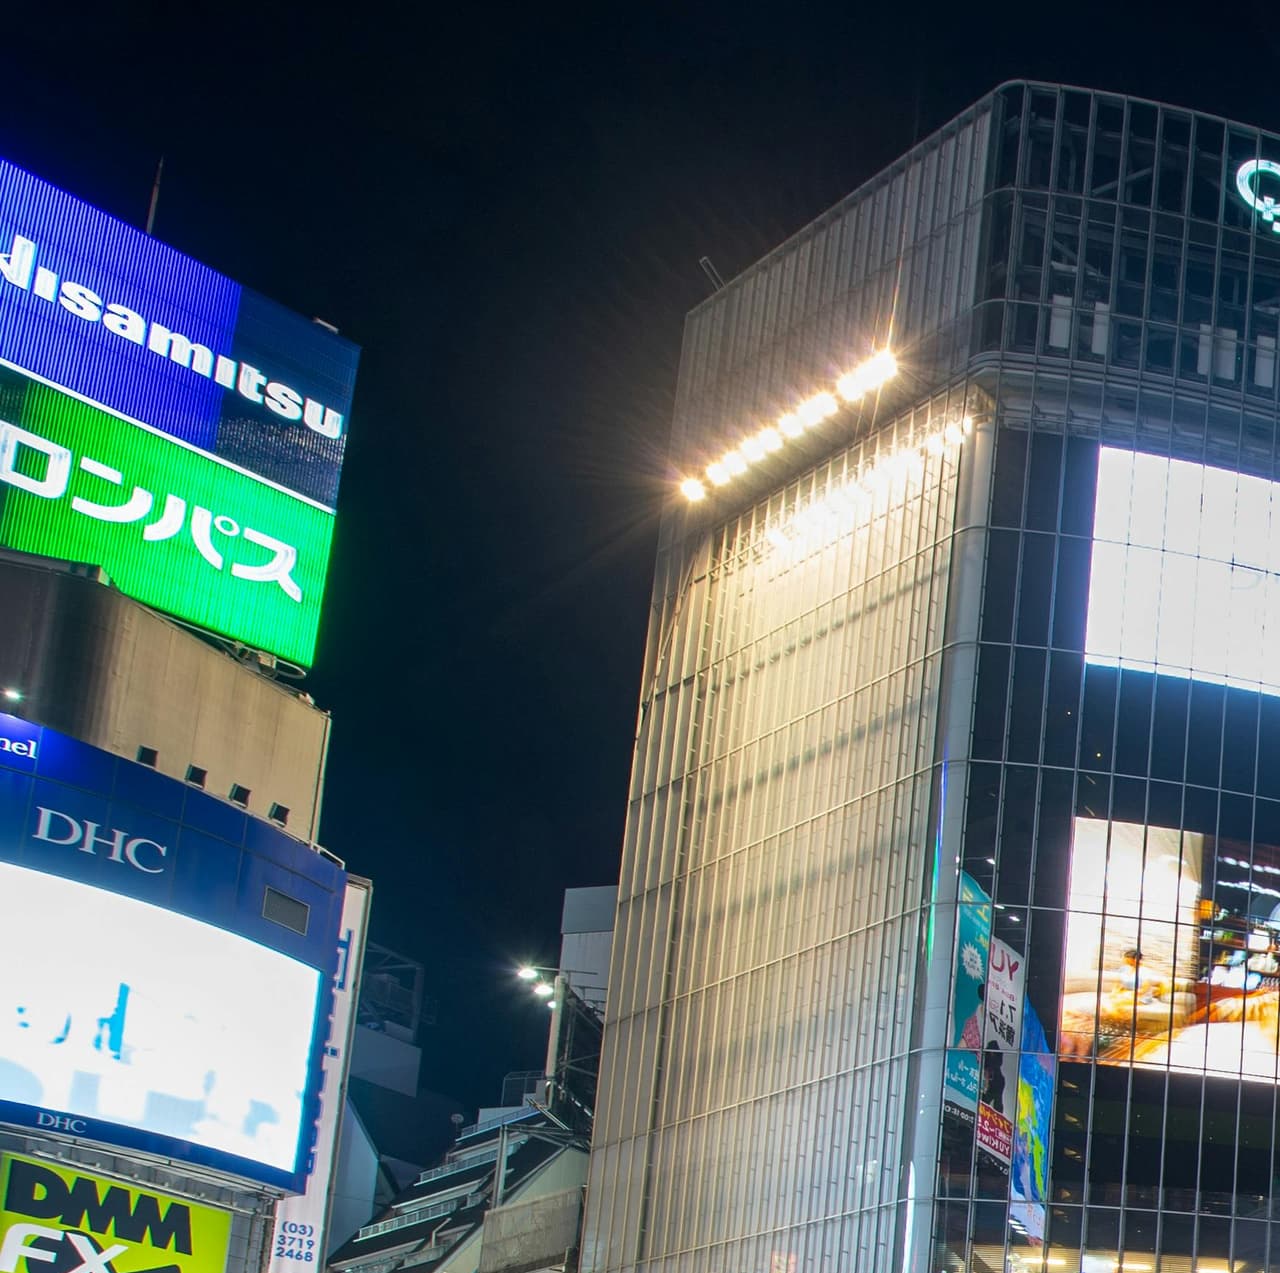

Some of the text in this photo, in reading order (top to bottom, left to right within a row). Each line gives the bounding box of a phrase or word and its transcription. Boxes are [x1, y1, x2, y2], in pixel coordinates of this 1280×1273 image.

[33, 806, 167, 873] DHC
[37, 1111, 87, 1134] DHC
[4, 1159, 193, 1256] DMM
[282, 1221, 314, 1237] (03)
[277, 1234, 314, 1250] 3719
[275, 1246, 313, 1263] 2468
